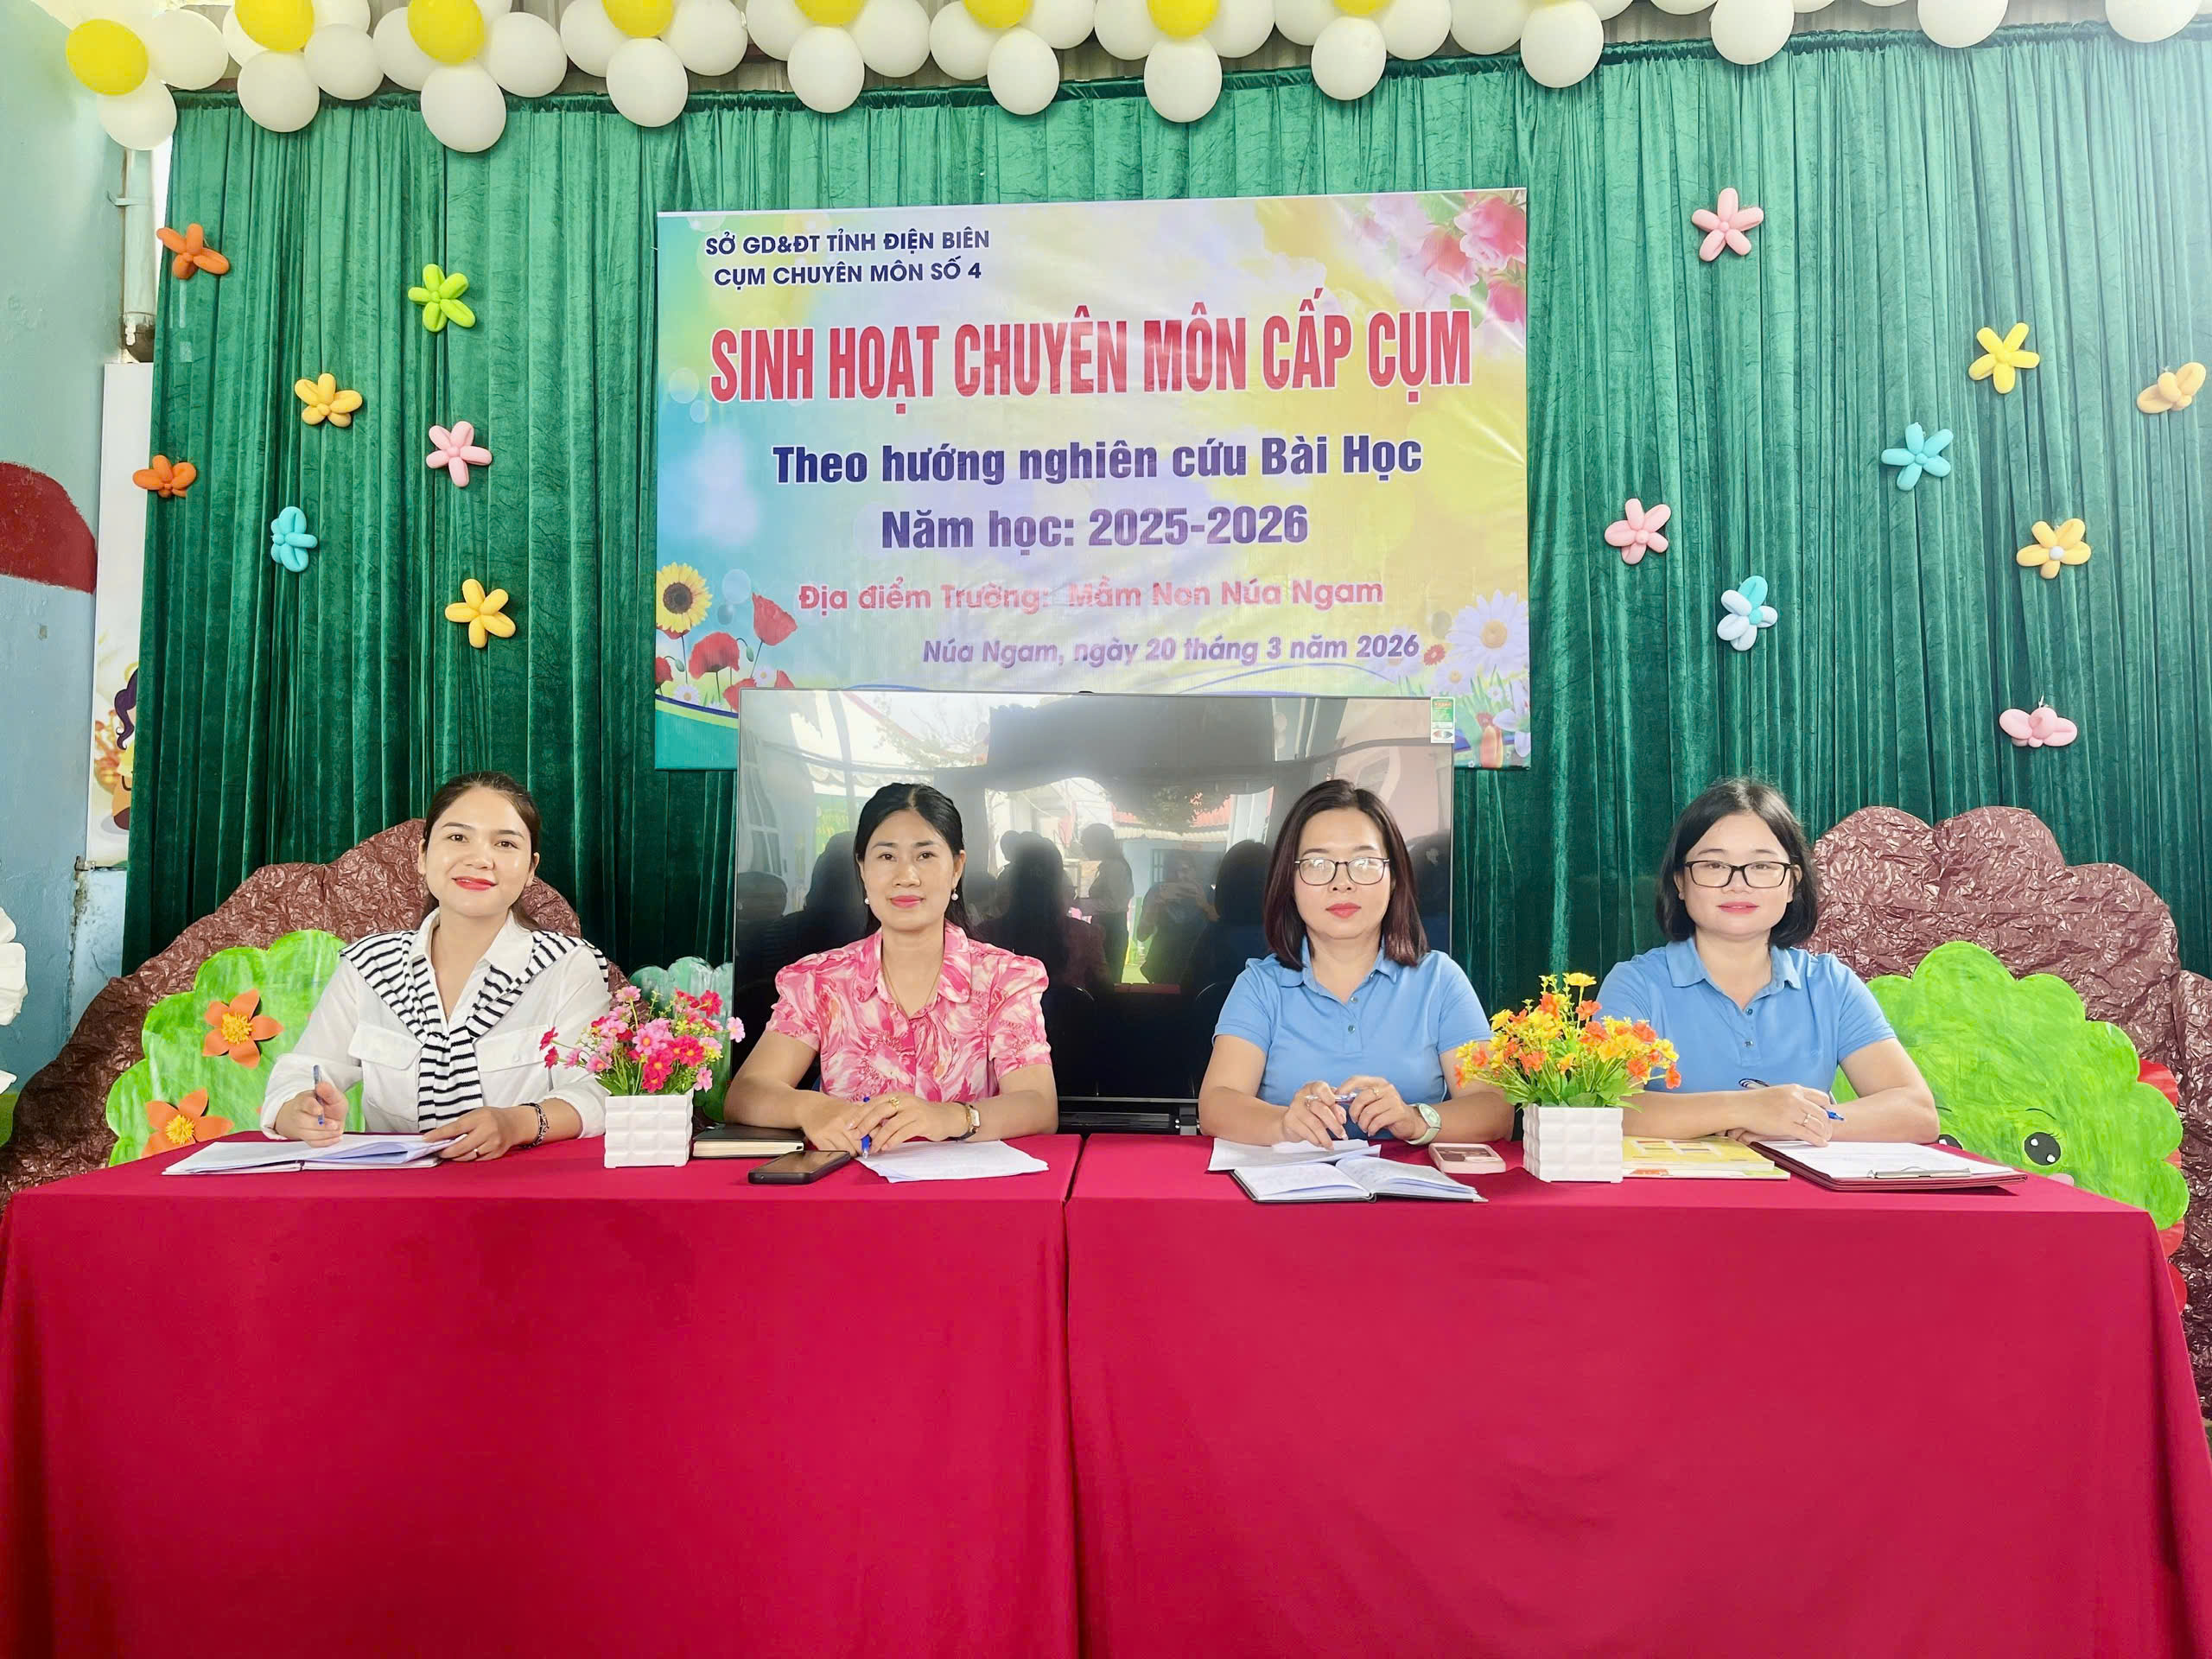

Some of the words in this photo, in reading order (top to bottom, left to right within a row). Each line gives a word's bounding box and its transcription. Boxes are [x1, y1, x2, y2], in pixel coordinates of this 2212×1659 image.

[706, 232, 735, 255] SỞ
[743, 235, 820, 255] GD&ĐT
[826, 228, 875, 252] TỈNH
[883, 227, 933, 255] ĐIỆN
[942, 226, 989, 249] BIÊN
[714, 268, 766, 290] CỤM
[773, 261, 862, 284] CHUYÊN
[870, 259, 924, 282] MÔN
[931, 256, 961, 280] SỐ
[968, 262, 982, 279] 4
[710, 327, 814, 403] SINH
[829, 325, 939, 415] HOẠT
[955, 305, 1127, 397] CHUYÊN
[1144, 302, 1246, 392] MÔN
[1262, 288, 1352, 390] CẤP
[1368, 310, 1471, 403] CỤM
[773, 446, 868, 484] Theo
[882, 444, 1005, 485] hướng
[1020, 440, 1157, 485] nghiên
[1173, 438, 1246, 476] cứu
[1262, 435, 1327, 475] Bài
[1344, 435, 1422, 481] Học
[882, 509, 974, 549] Năm
[988, 510, 1074, 556] học:
[1089, 505, 1308, 546] 2025-2026
[799, 585, 848, 616] Địa
[858, 576, 931, 609] điểm
[1068, 575, 1141, 607] Mầm
[1153, 582, 1210, 606] Non
[1221, 578, 1281, 606] Núa
[1292, 580, 1383, 610] Ngam
[923, 638, 974, 663] Núa
[982, 640, 1064, 669] Ngam,
[1074, 637, 1139, 668] ngày
[1145, 636, 1176, 661] 20
[1185, 635, 1259, 666] tháng
[1267, 637, 1281, 659] 3
[1290, 634, 1347, 659] năm
[1357, 634, 1420, 658] 2026
